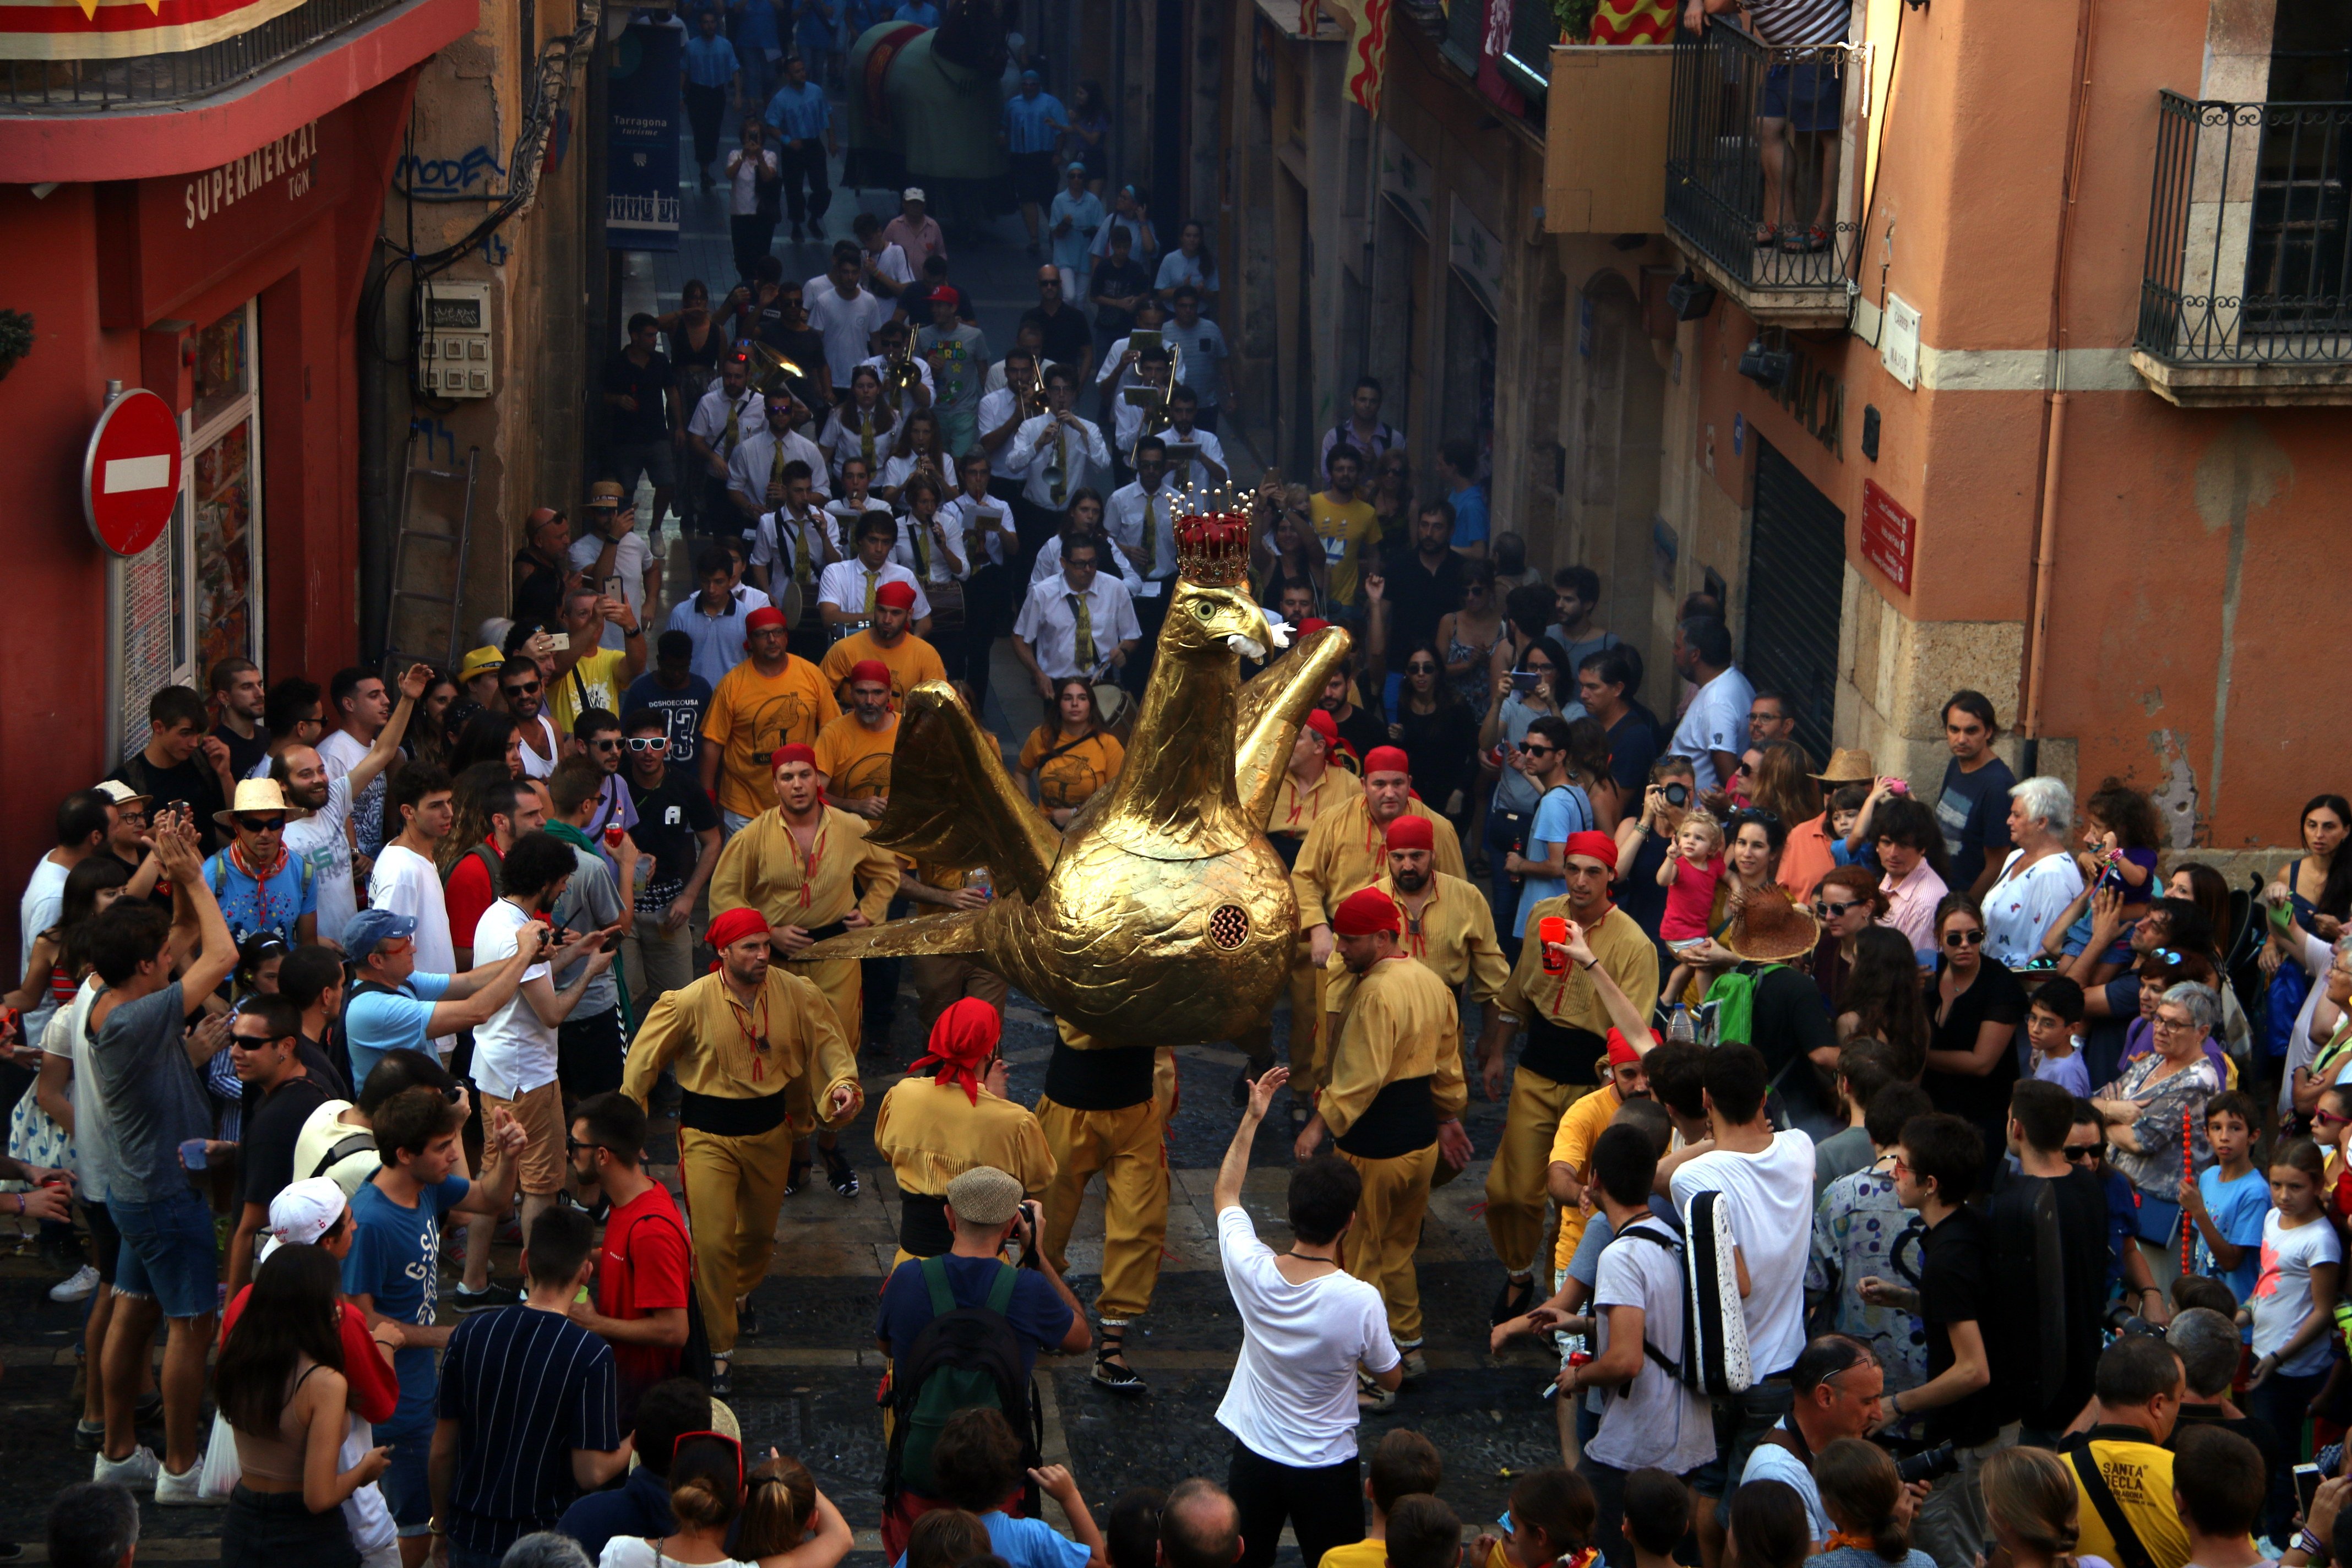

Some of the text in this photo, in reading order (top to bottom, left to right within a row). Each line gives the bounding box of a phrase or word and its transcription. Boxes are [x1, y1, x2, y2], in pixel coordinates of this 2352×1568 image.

[613, 115, 667, 128] Tarragona
[622, 128, 658, 137] turisme
[185, 117, 318, 230] SUPERMERCAT
[288, 167, 310, 201] TGN
[1894, 312, 1908, 331] CARRER
[1890, 346, 1908, 374] MAJOR
[649, 699, 699, 708] DCSHOECOUSA
[2103, 1462, 2143, 1478] SANTA
[2104, 1474, 2143, 1491] TECLA
